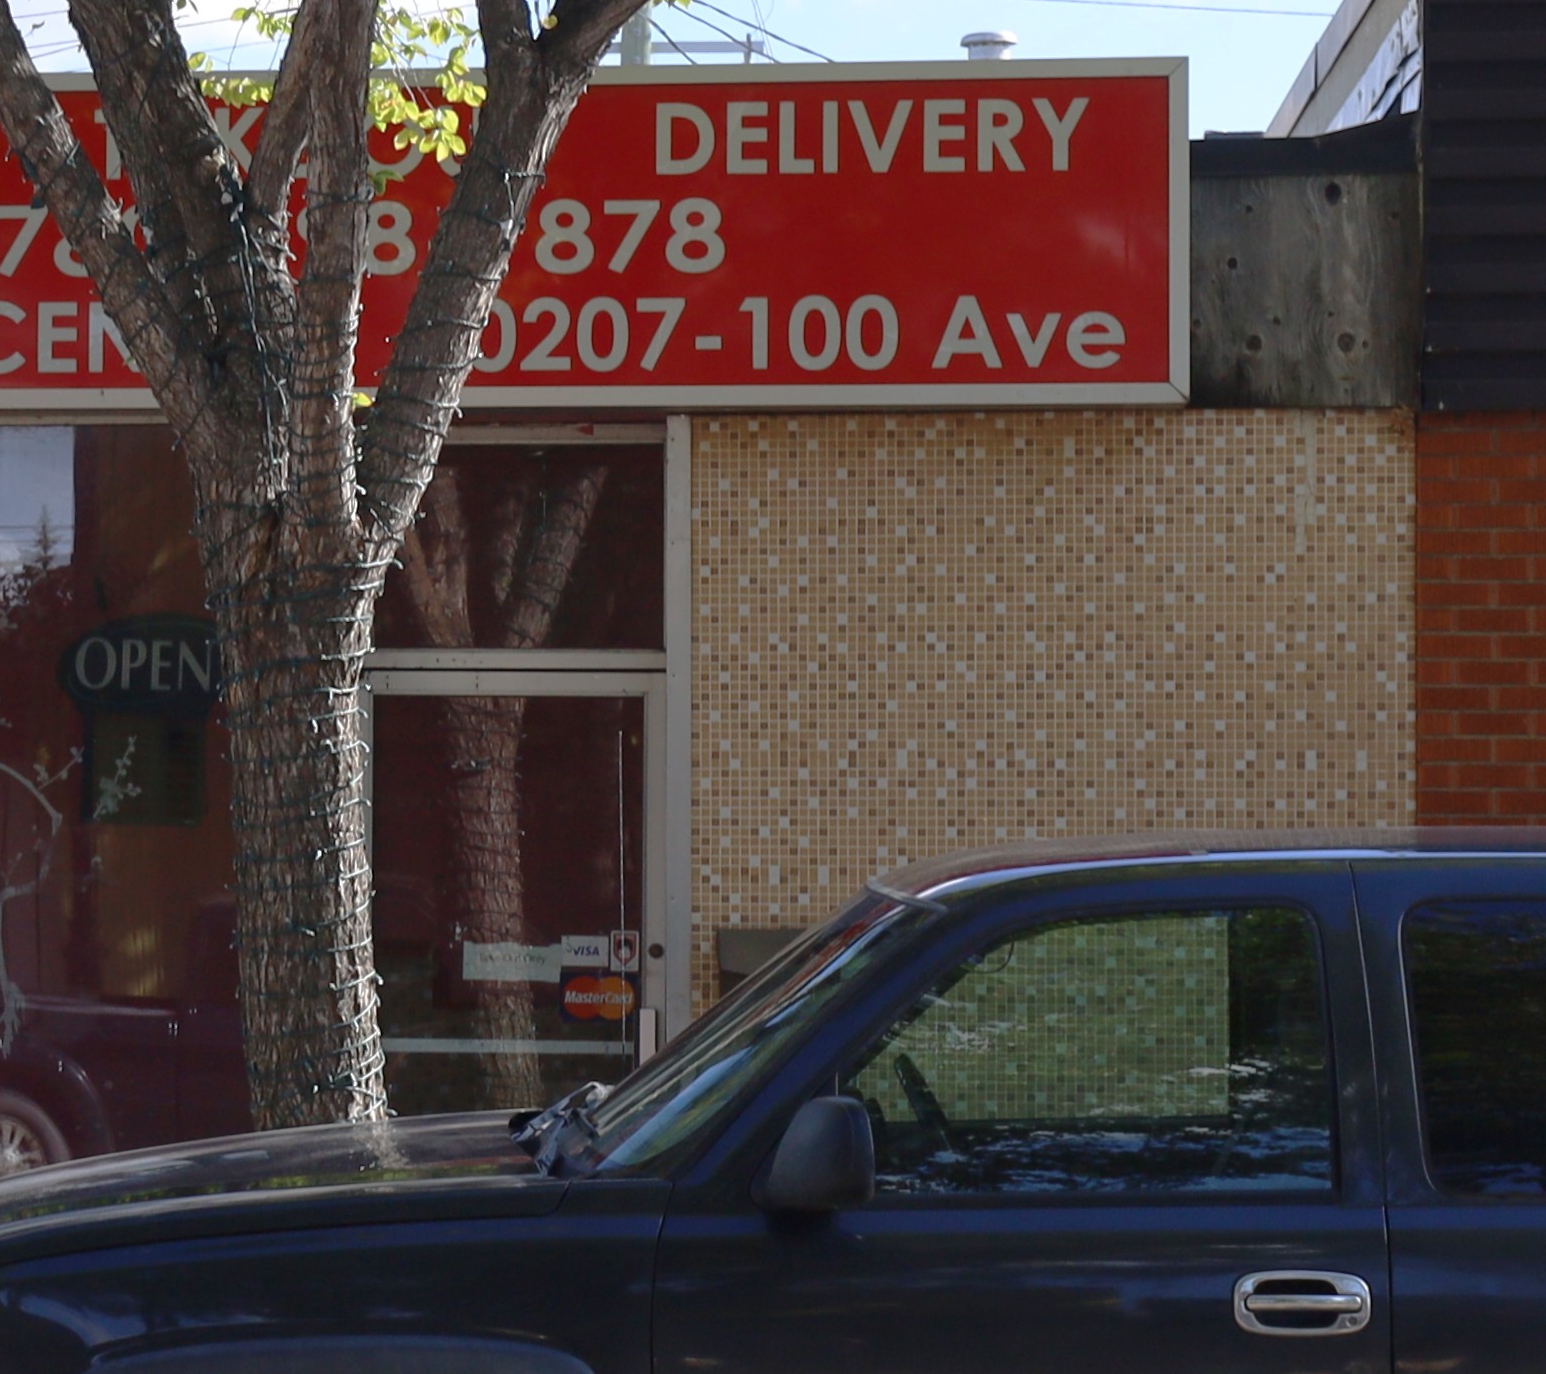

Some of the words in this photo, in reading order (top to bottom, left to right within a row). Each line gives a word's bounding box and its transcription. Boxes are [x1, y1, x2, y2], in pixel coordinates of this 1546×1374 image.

[654, 97, 1090, 177] DELIVERY
[470, 293, 901, 374] 0207-100
[931, 294, 1128, 370] Ave
[74, 636, 214, 692] OPEN
[573, 945, 600, 957] VISA
[564, 990, 634, 1005] MasterCard
